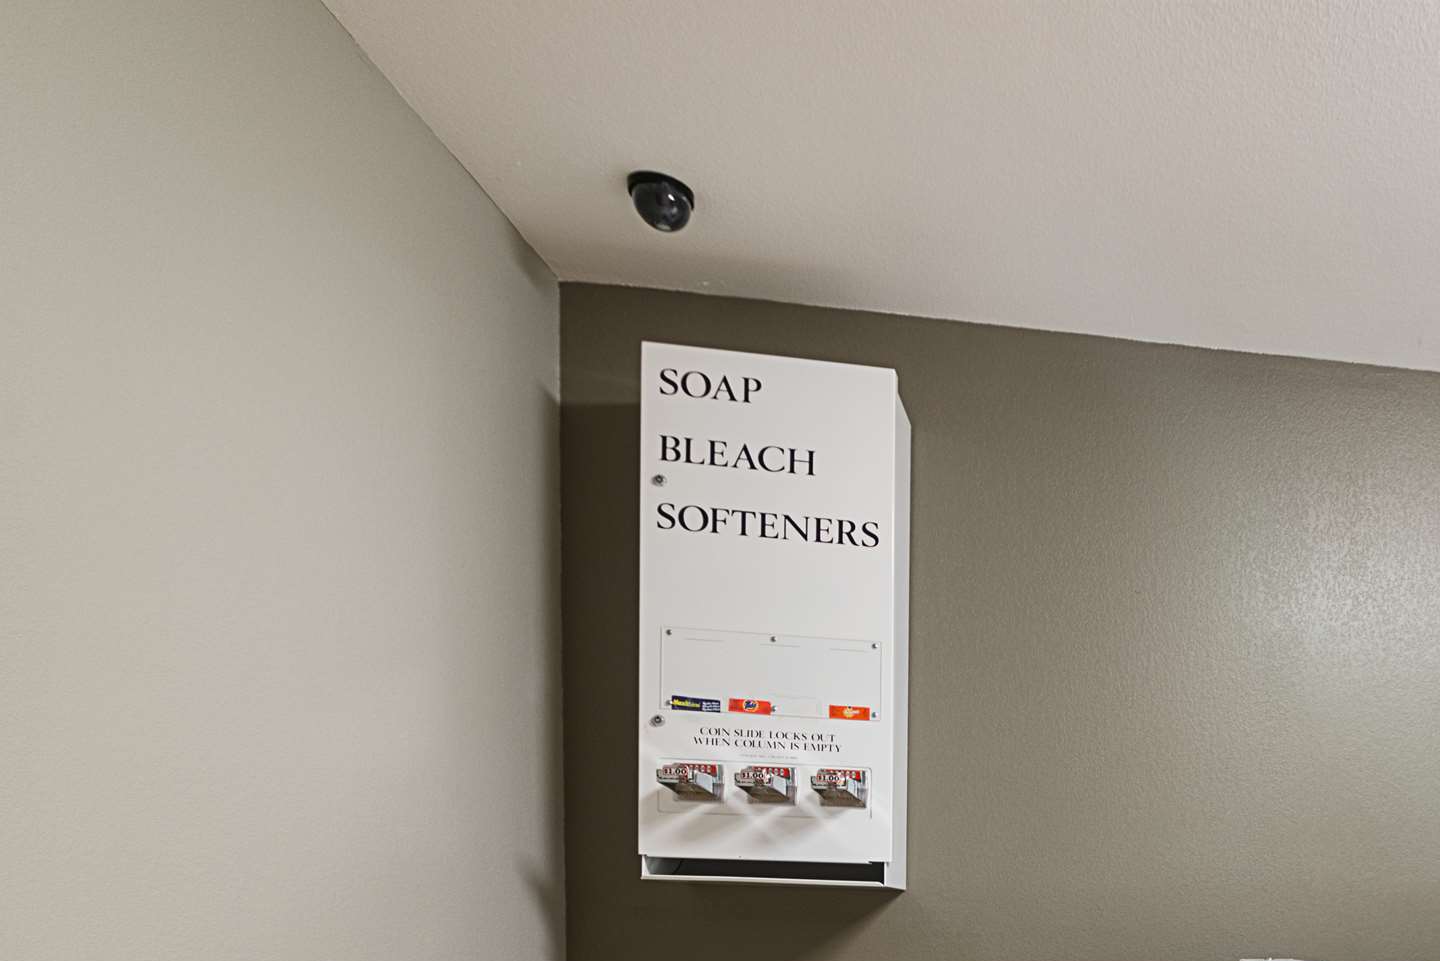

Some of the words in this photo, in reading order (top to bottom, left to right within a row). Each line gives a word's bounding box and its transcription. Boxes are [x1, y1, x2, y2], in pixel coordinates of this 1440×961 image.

[659, 368, 762, 403] SOAP
[659, 434, 816, 476] BLEACH
[656, 502, 880, 548] SOFTENERS
[700, 727, 731, 737] COIN
[734, 729, 764, 739] SLIDE
[769, 730, 808, 741] LOCKS
[811, 733, 836, 743] OUT
[693, 736, 731, 746] WHEN
[734, 740, 786, 750] COLUMN
[790, 743, 800, 751] IS
[804, 743, 842, 753] EMPTY
[664, 767, 687, 775] $1.00
[817, 774, 840, 782] $1.00
